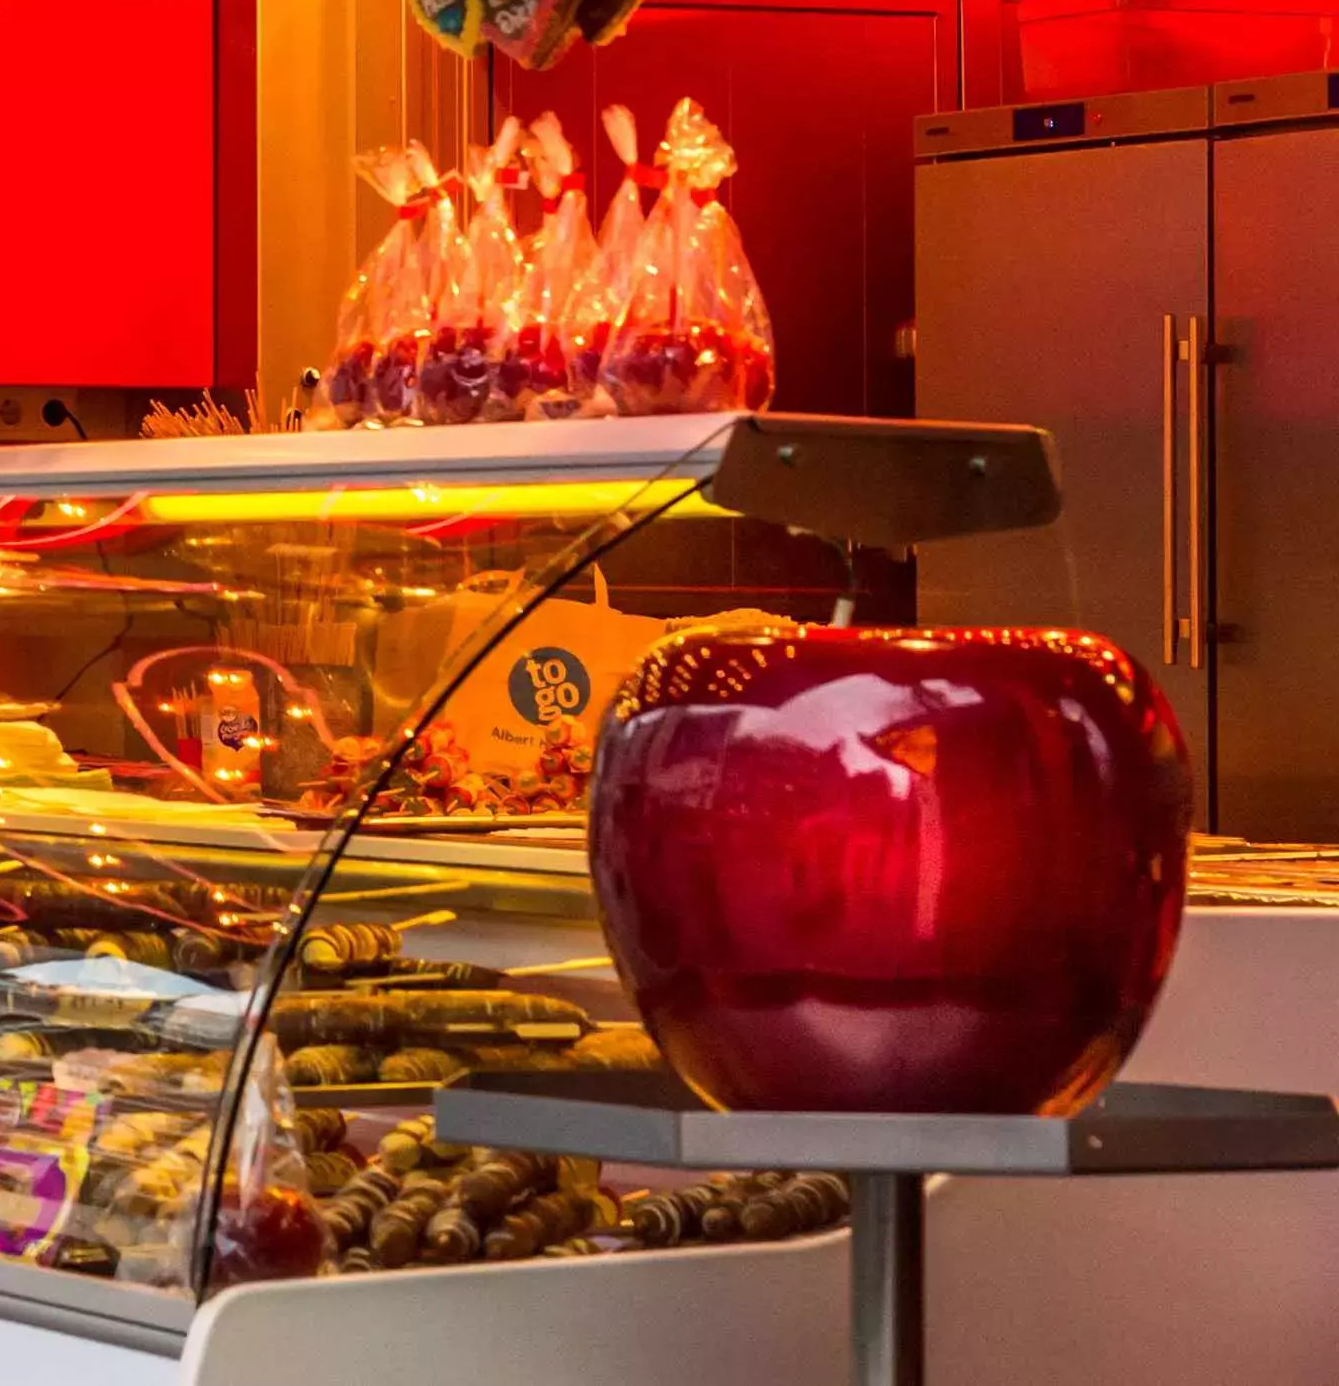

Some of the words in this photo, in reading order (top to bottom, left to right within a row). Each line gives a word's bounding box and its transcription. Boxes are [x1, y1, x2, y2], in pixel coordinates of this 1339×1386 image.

[526, 658, 567, 689] to
[535, 681, 580, 722] go
[491, 726, 535, 746] Albert
